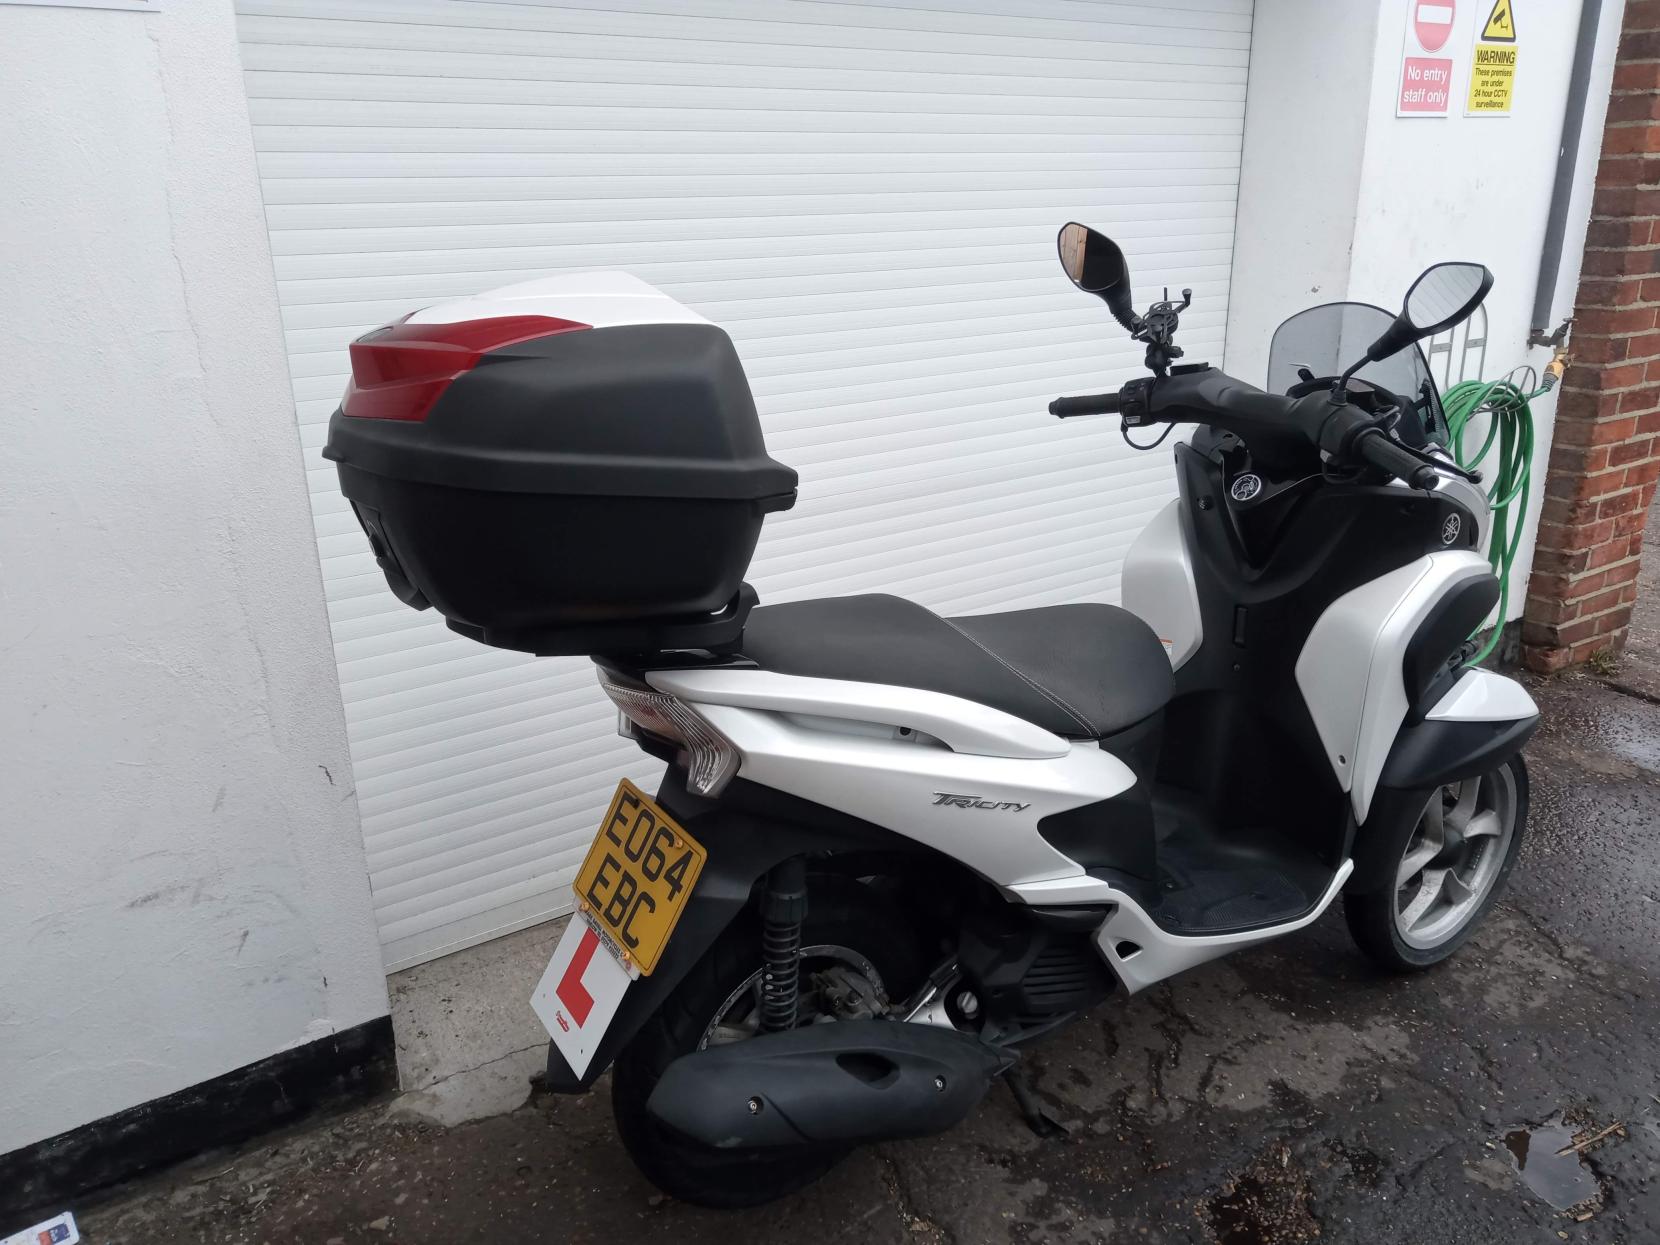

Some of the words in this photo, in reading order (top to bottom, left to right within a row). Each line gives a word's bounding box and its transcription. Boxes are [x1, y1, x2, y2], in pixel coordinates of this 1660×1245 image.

[1477, 50, 1516, 64] WARNING
[1407, 66, 1421, 80] No
[1423, 67, 1448, 85] entry
[1475, 68, 1490, 76] These
[1490, 69, 1512, 77] premises
[1490, 79, 1504, 87] under
[1403, 88, 1426, 103] staff
[1427, 88, 1447, 106] only
[1474, 89, 1481, 97] 24
[1481, 89, 1493, 97] hour
[1475, 100, 1504, 108] surveillance
[586, 852, 656, 949] EBC
[556, 926, 600, 1029] L
